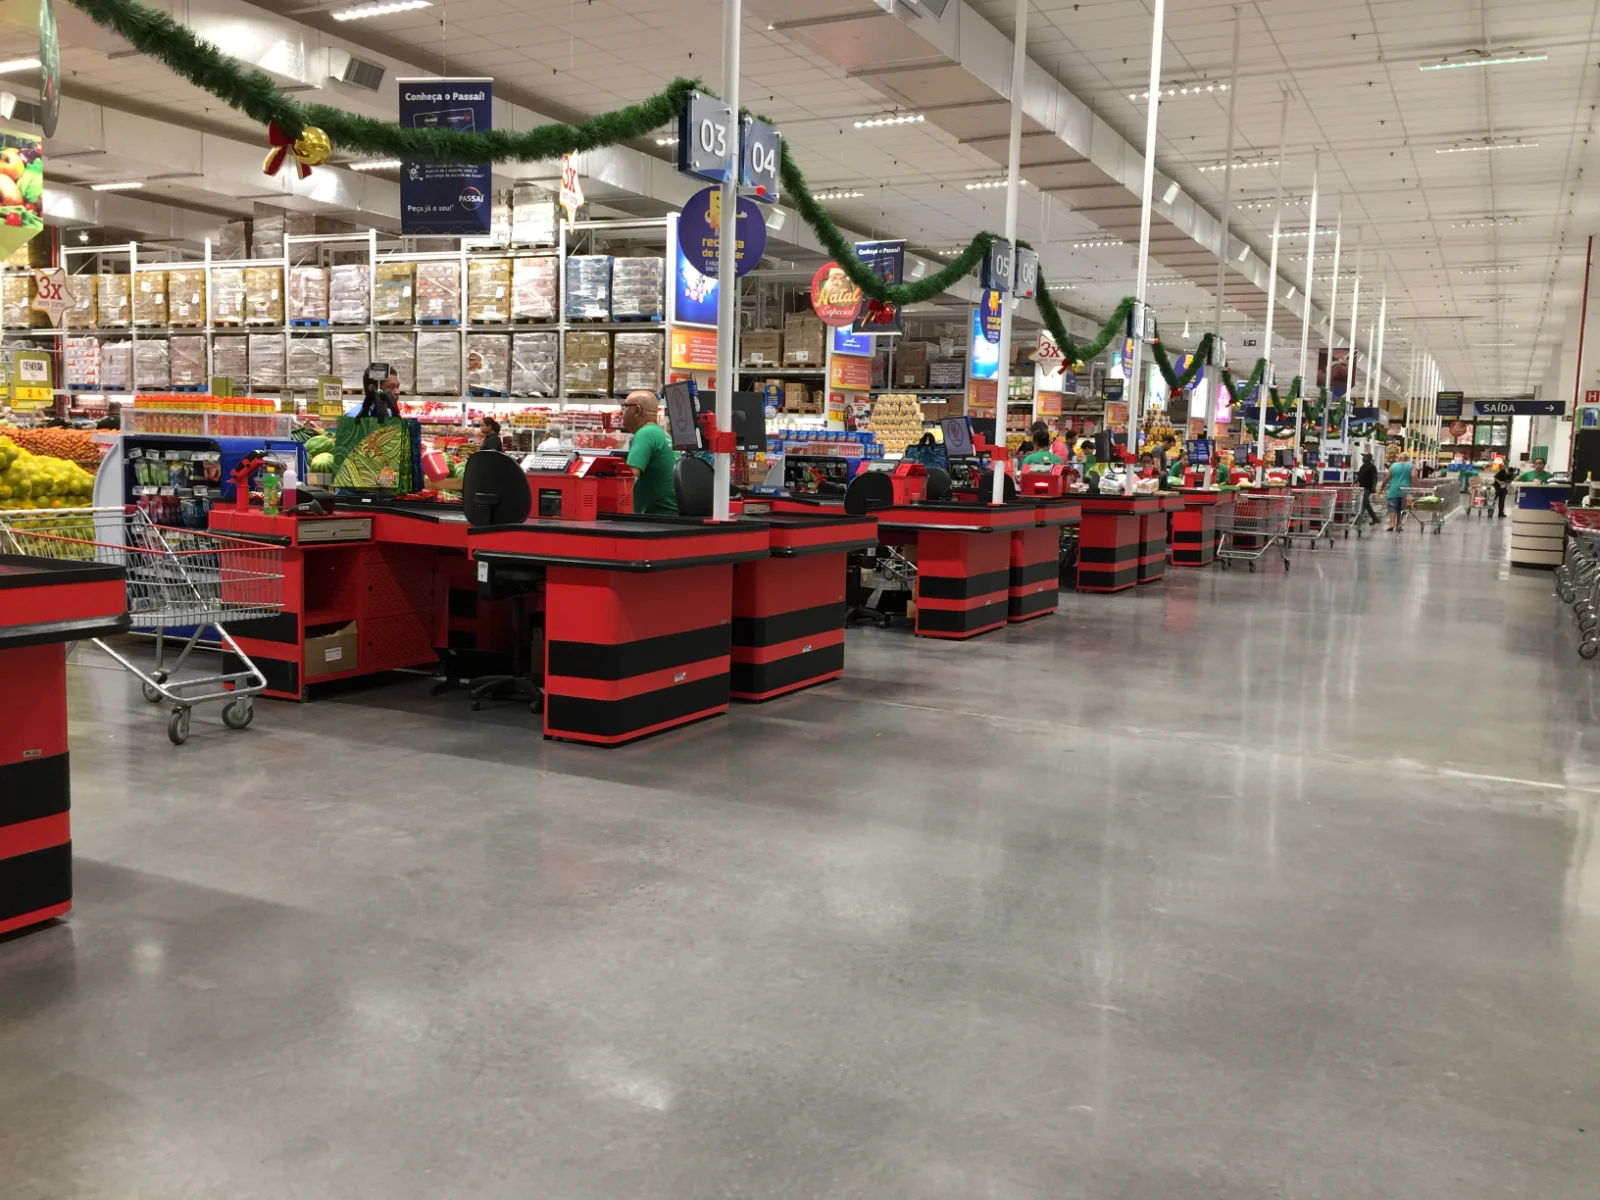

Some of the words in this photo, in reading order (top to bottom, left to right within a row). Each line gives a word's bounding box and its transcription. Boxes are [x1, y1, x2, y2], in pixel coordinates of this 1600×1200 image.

[405, 92, 442, 103] Conheça
[453, 90, 485, 101] Passaí!
[700, 118, 727, 158] 03
[752, 141, 776, 179] 04
[563, 155, 576, 193] 3x
[459, 194, 485, 203] PASSAÍ
[407, 205, 423, 213] Peça
[424, 204, 431, 213] já
[702, 238, 745, 251] recga
[702, 249, 713, 257] de
[996, 254, 1010, 277] 05
[1023, 263, 1035, 284] 06
[38, 276, 63, 300] 3x
[815, 287, 861, 307] Natal
[822, 304, 855, 318] Especial
[1147, 317, 1154, 333] 08
[674, 343, 687, 355] 13
[1039, 341, 1060, 358] 3x
[23, 360, 44, 372] CENOURA
[833, 367, 843, 378] 12
[1588, 391, 1597, 402] H
[1483, 402, 1516, 413] SAÍDA
